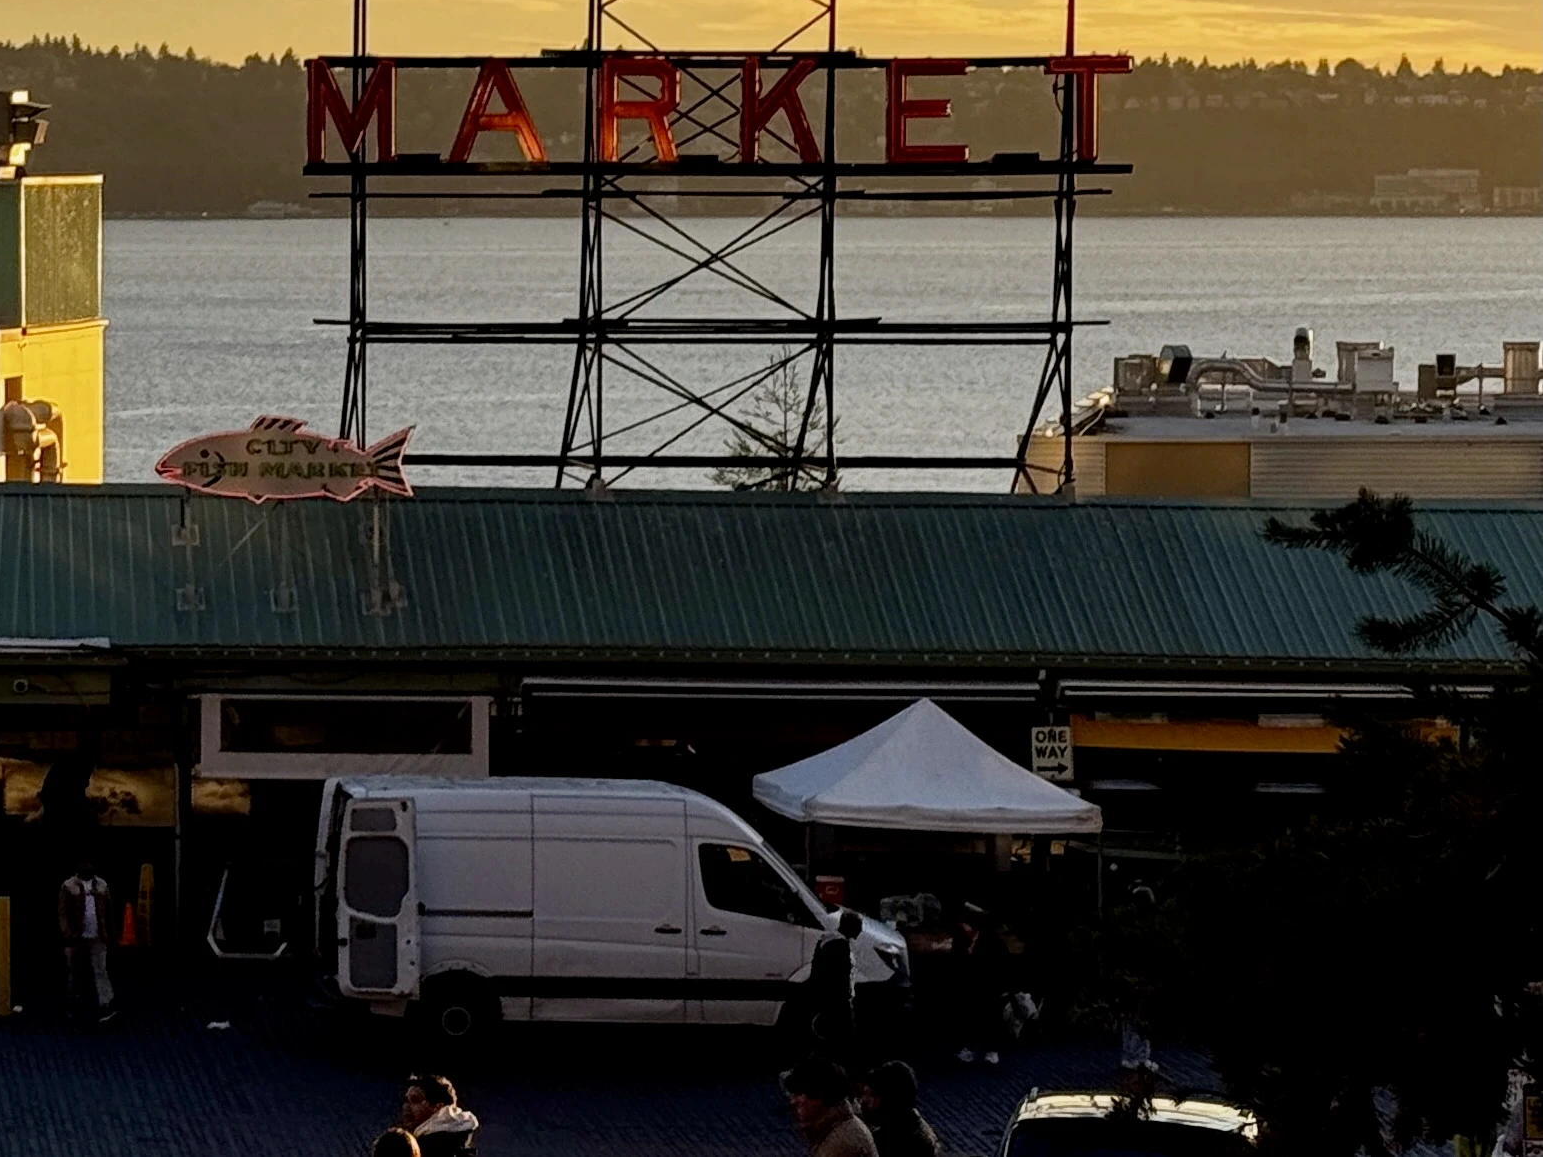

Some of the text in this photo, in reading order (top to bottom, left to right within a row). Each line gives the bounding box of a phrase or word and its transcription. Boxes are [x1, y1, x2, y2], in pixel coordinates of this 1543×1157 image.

[307, 56, 1135, 164] MARKET
[246, 438, 321, 455] CITY
[182, 461, 379, 478] FISH MARKET
[1035, 729, 1067, 743] ONE
[1035, 745, 1068, 759] WAY
